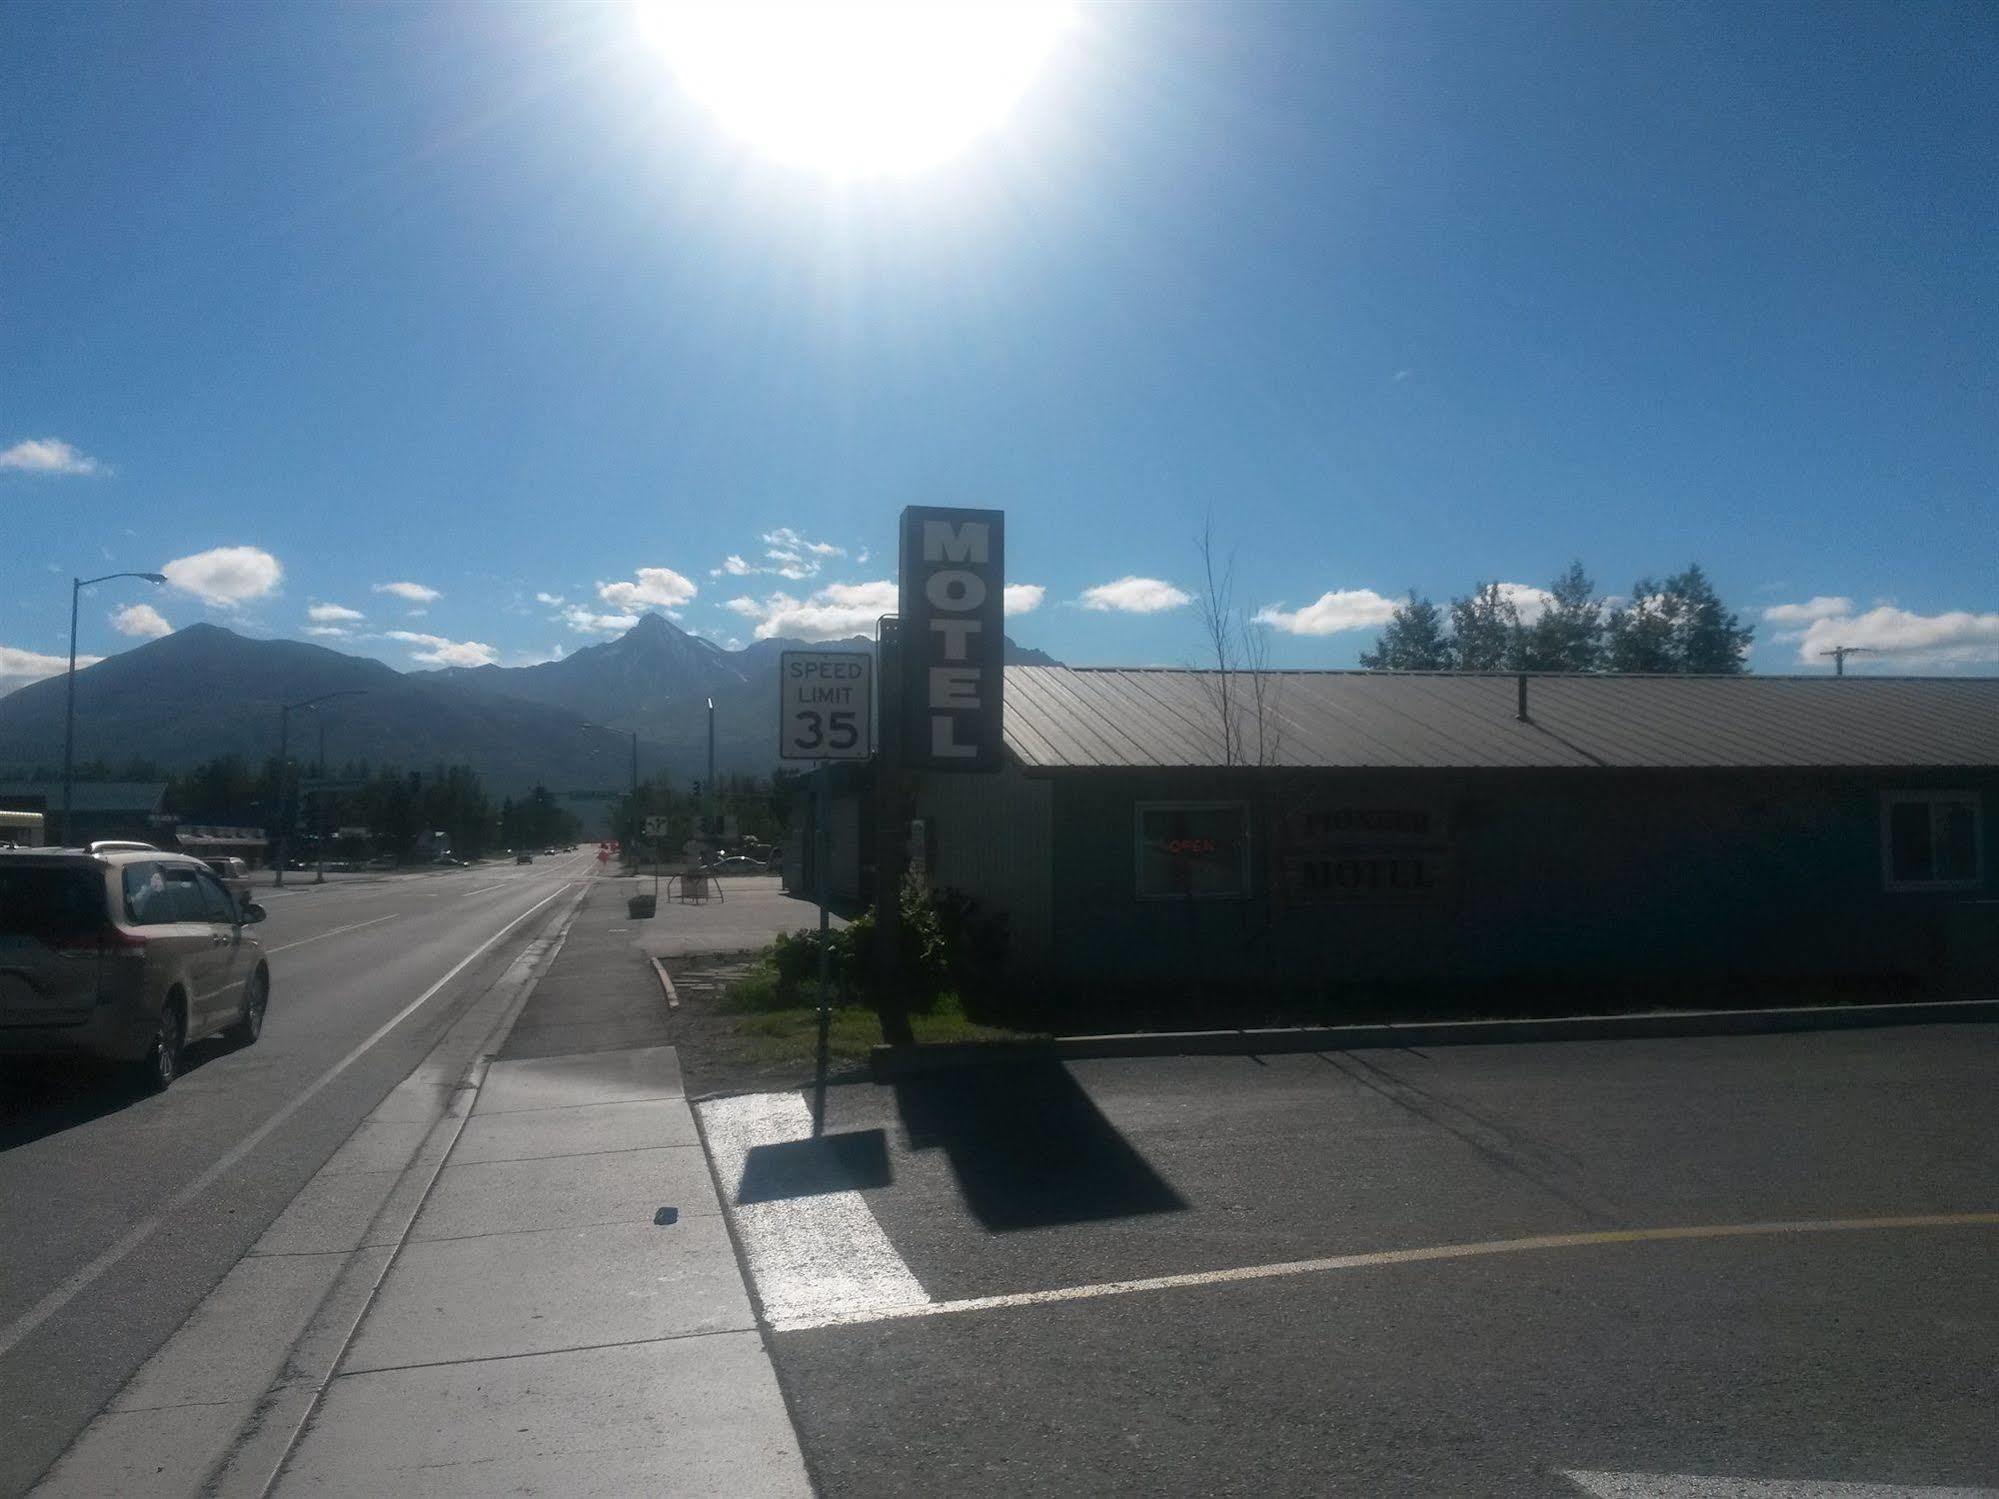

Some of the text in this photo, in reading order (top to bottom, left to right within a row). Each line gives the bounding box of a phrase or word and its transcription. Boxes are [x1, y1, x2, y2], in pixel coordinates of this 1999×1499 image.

[923, 520, 989, 757] MOTEL
[791, 662, 862, 679] SPEED
[798, 687, 853, 704] LIMIT
[794, 711, 858, 749] 35
[1168, 839, 1217, 854] OPEN
